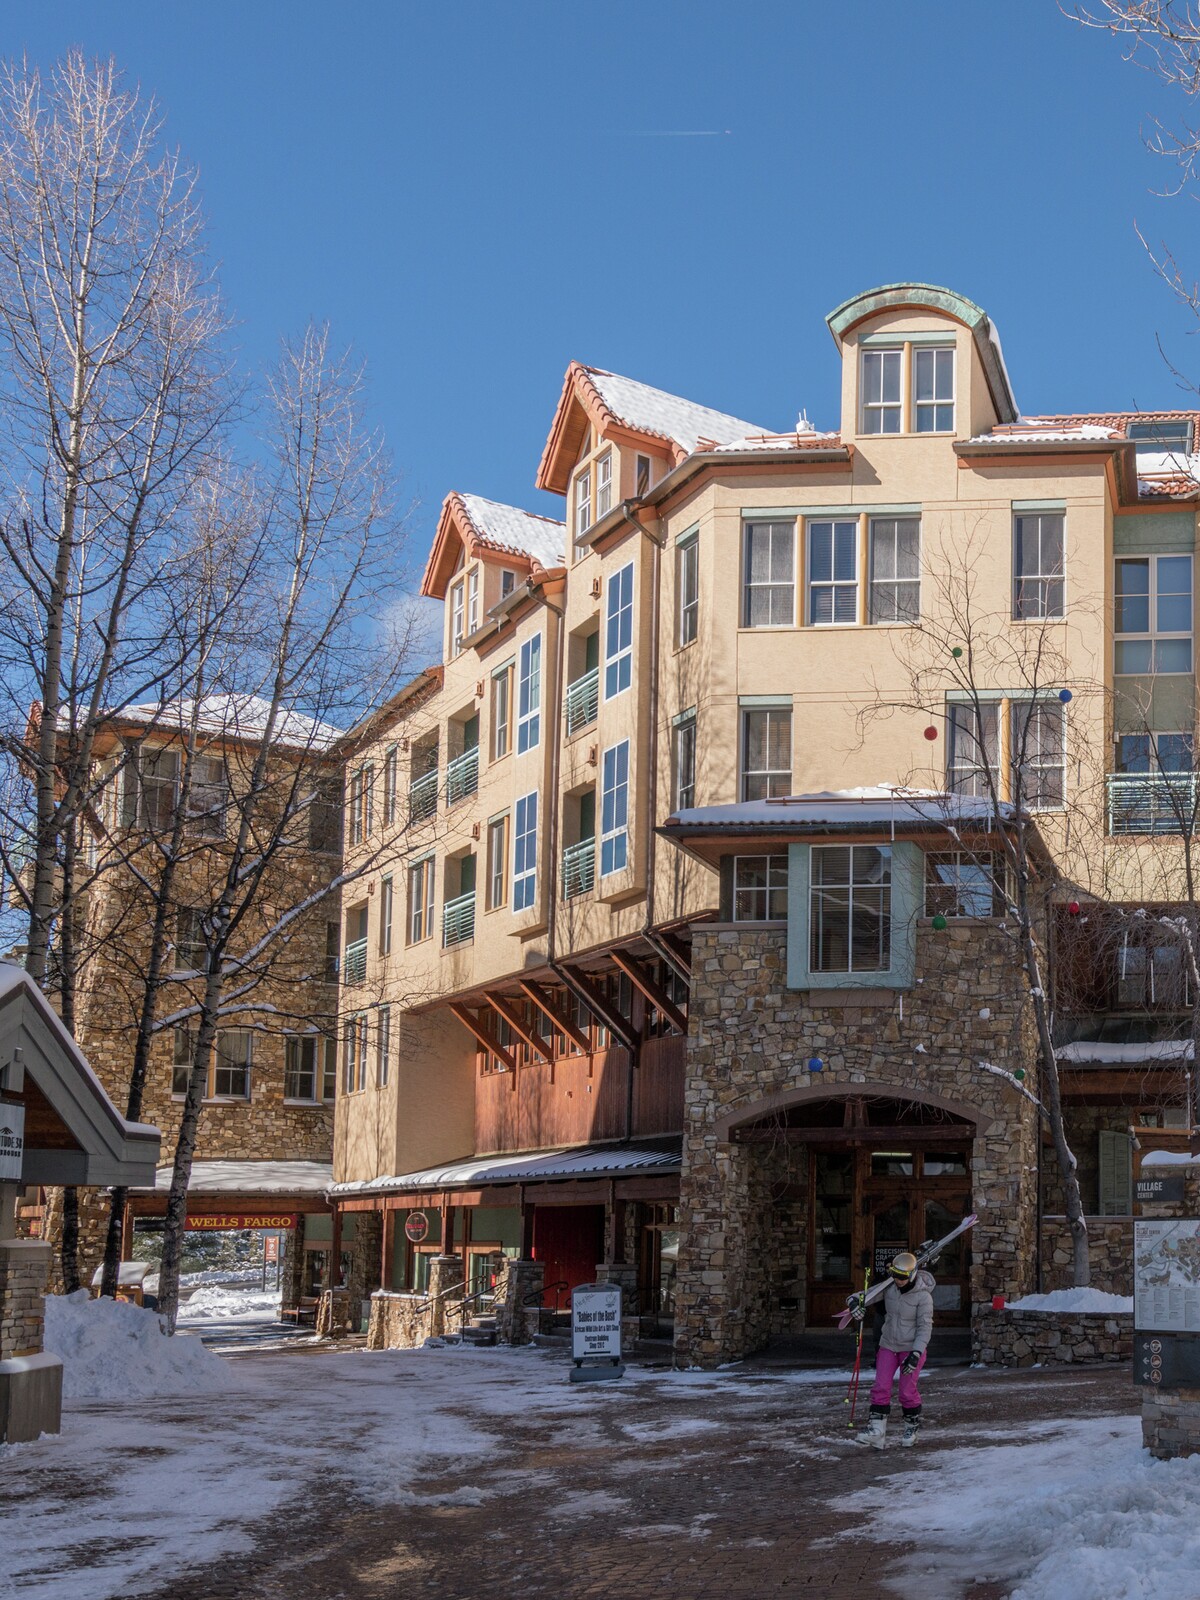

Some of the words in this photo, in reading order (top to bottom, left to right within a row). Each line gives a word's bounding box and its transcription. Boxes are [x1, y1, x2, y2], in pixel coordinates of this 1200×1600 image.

[1137, 1181, 1163, 1191] VILLAGE
[189, 1217, 239, 1227] WELLS
[243, 1217, 291, 1227] FARGO
